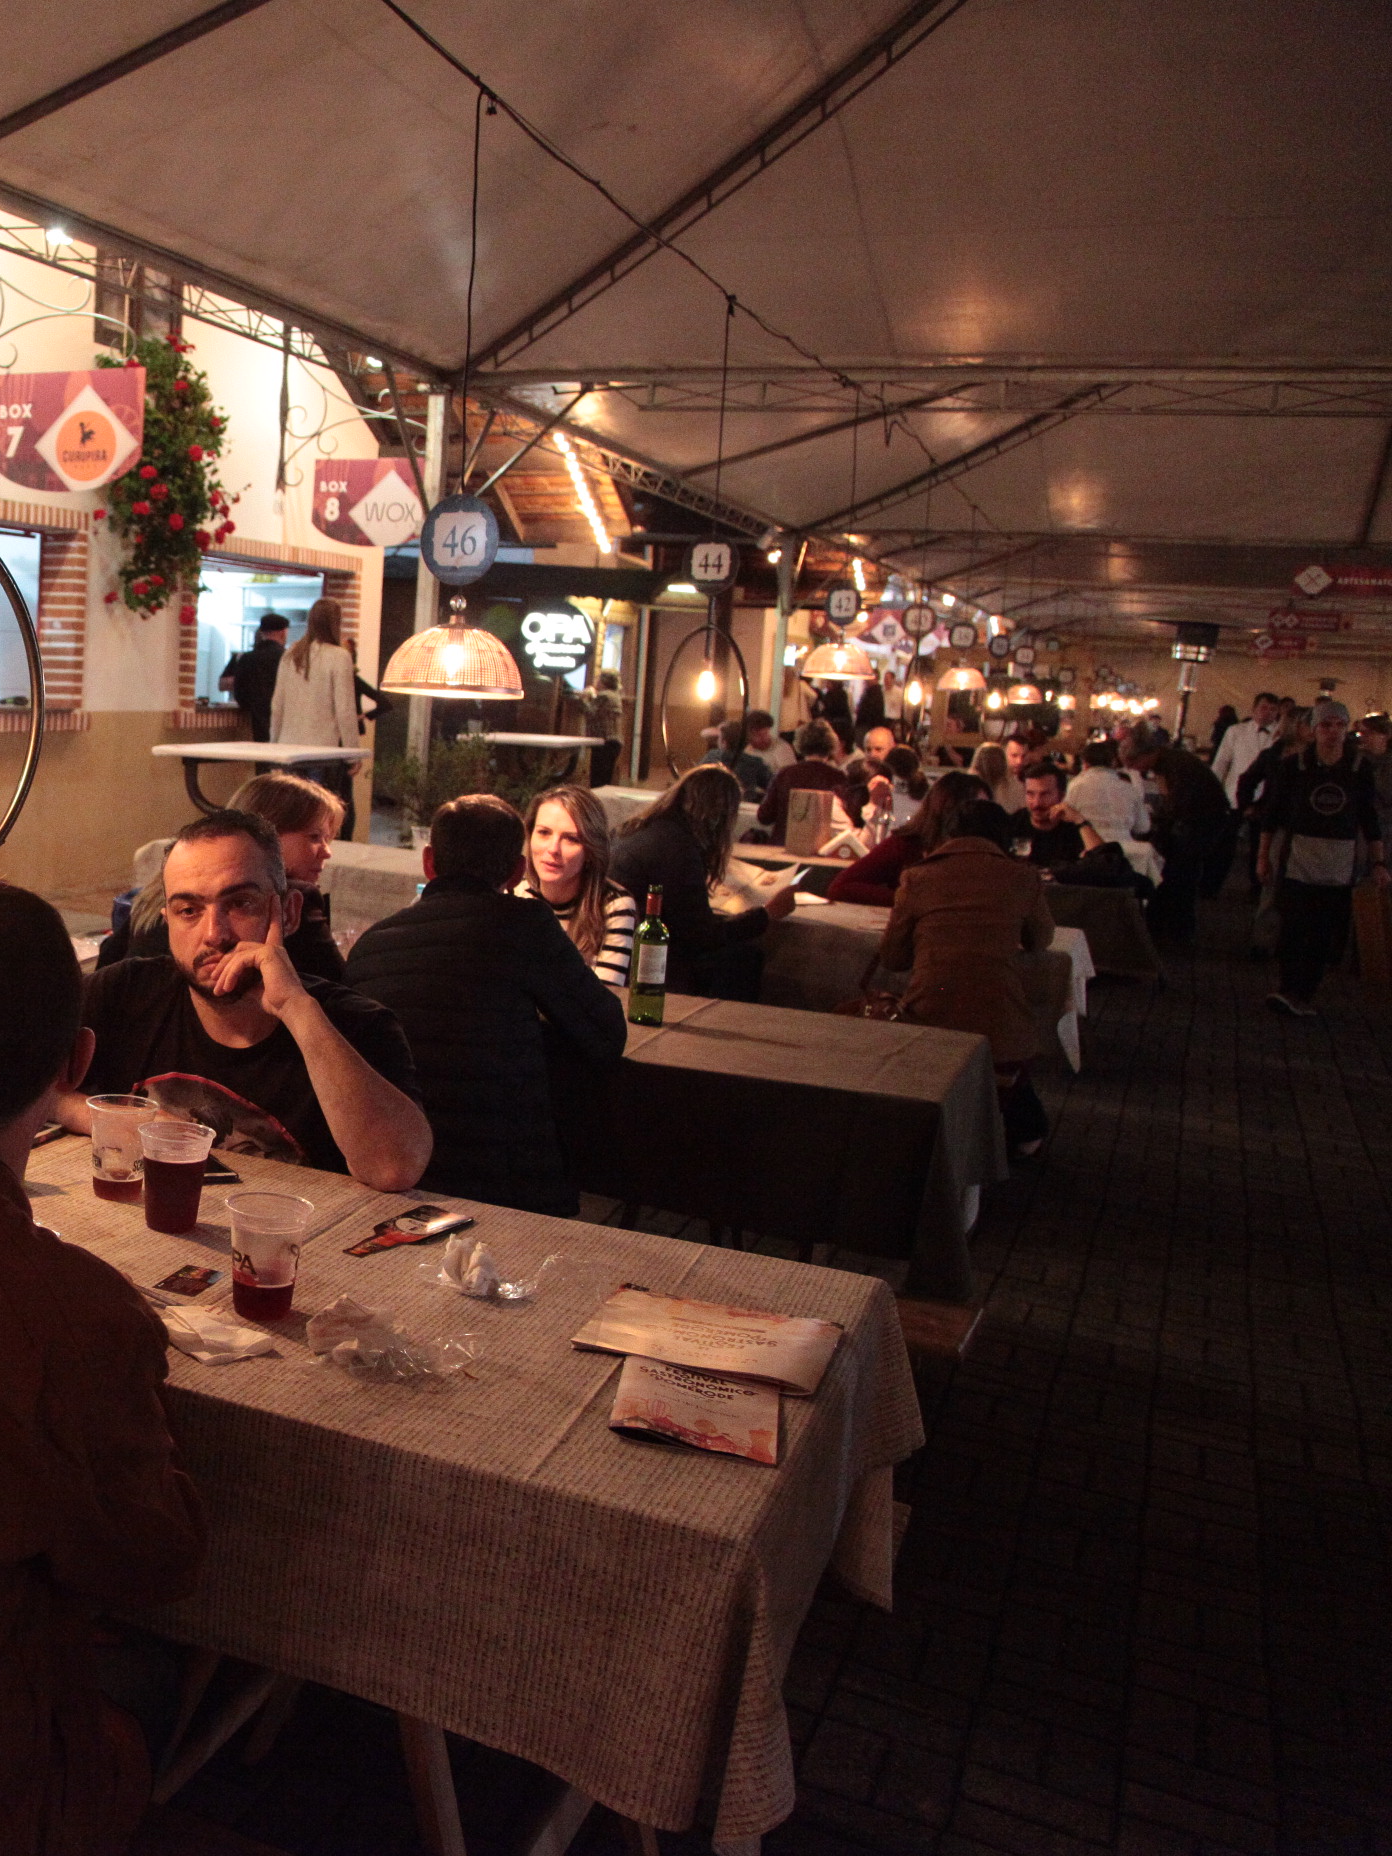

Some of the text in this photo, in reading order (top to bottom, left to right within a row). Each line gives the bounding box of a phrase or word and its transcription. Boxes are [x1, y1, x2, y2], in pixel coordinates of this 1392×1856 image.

[5, 425, 24, 459] 7
[319, 480, 348, 493] BOX
[324, 496, 340, 522] 8
[365, 501, 417, 524] WOX
[442, 524, 477, 558] 46
[698, 551, 723, 574] 44
[835, 596, 850, 612] 42
[520, 611, 592, 644] OPA
[650, 1373, 735, 1400] POMERODE
